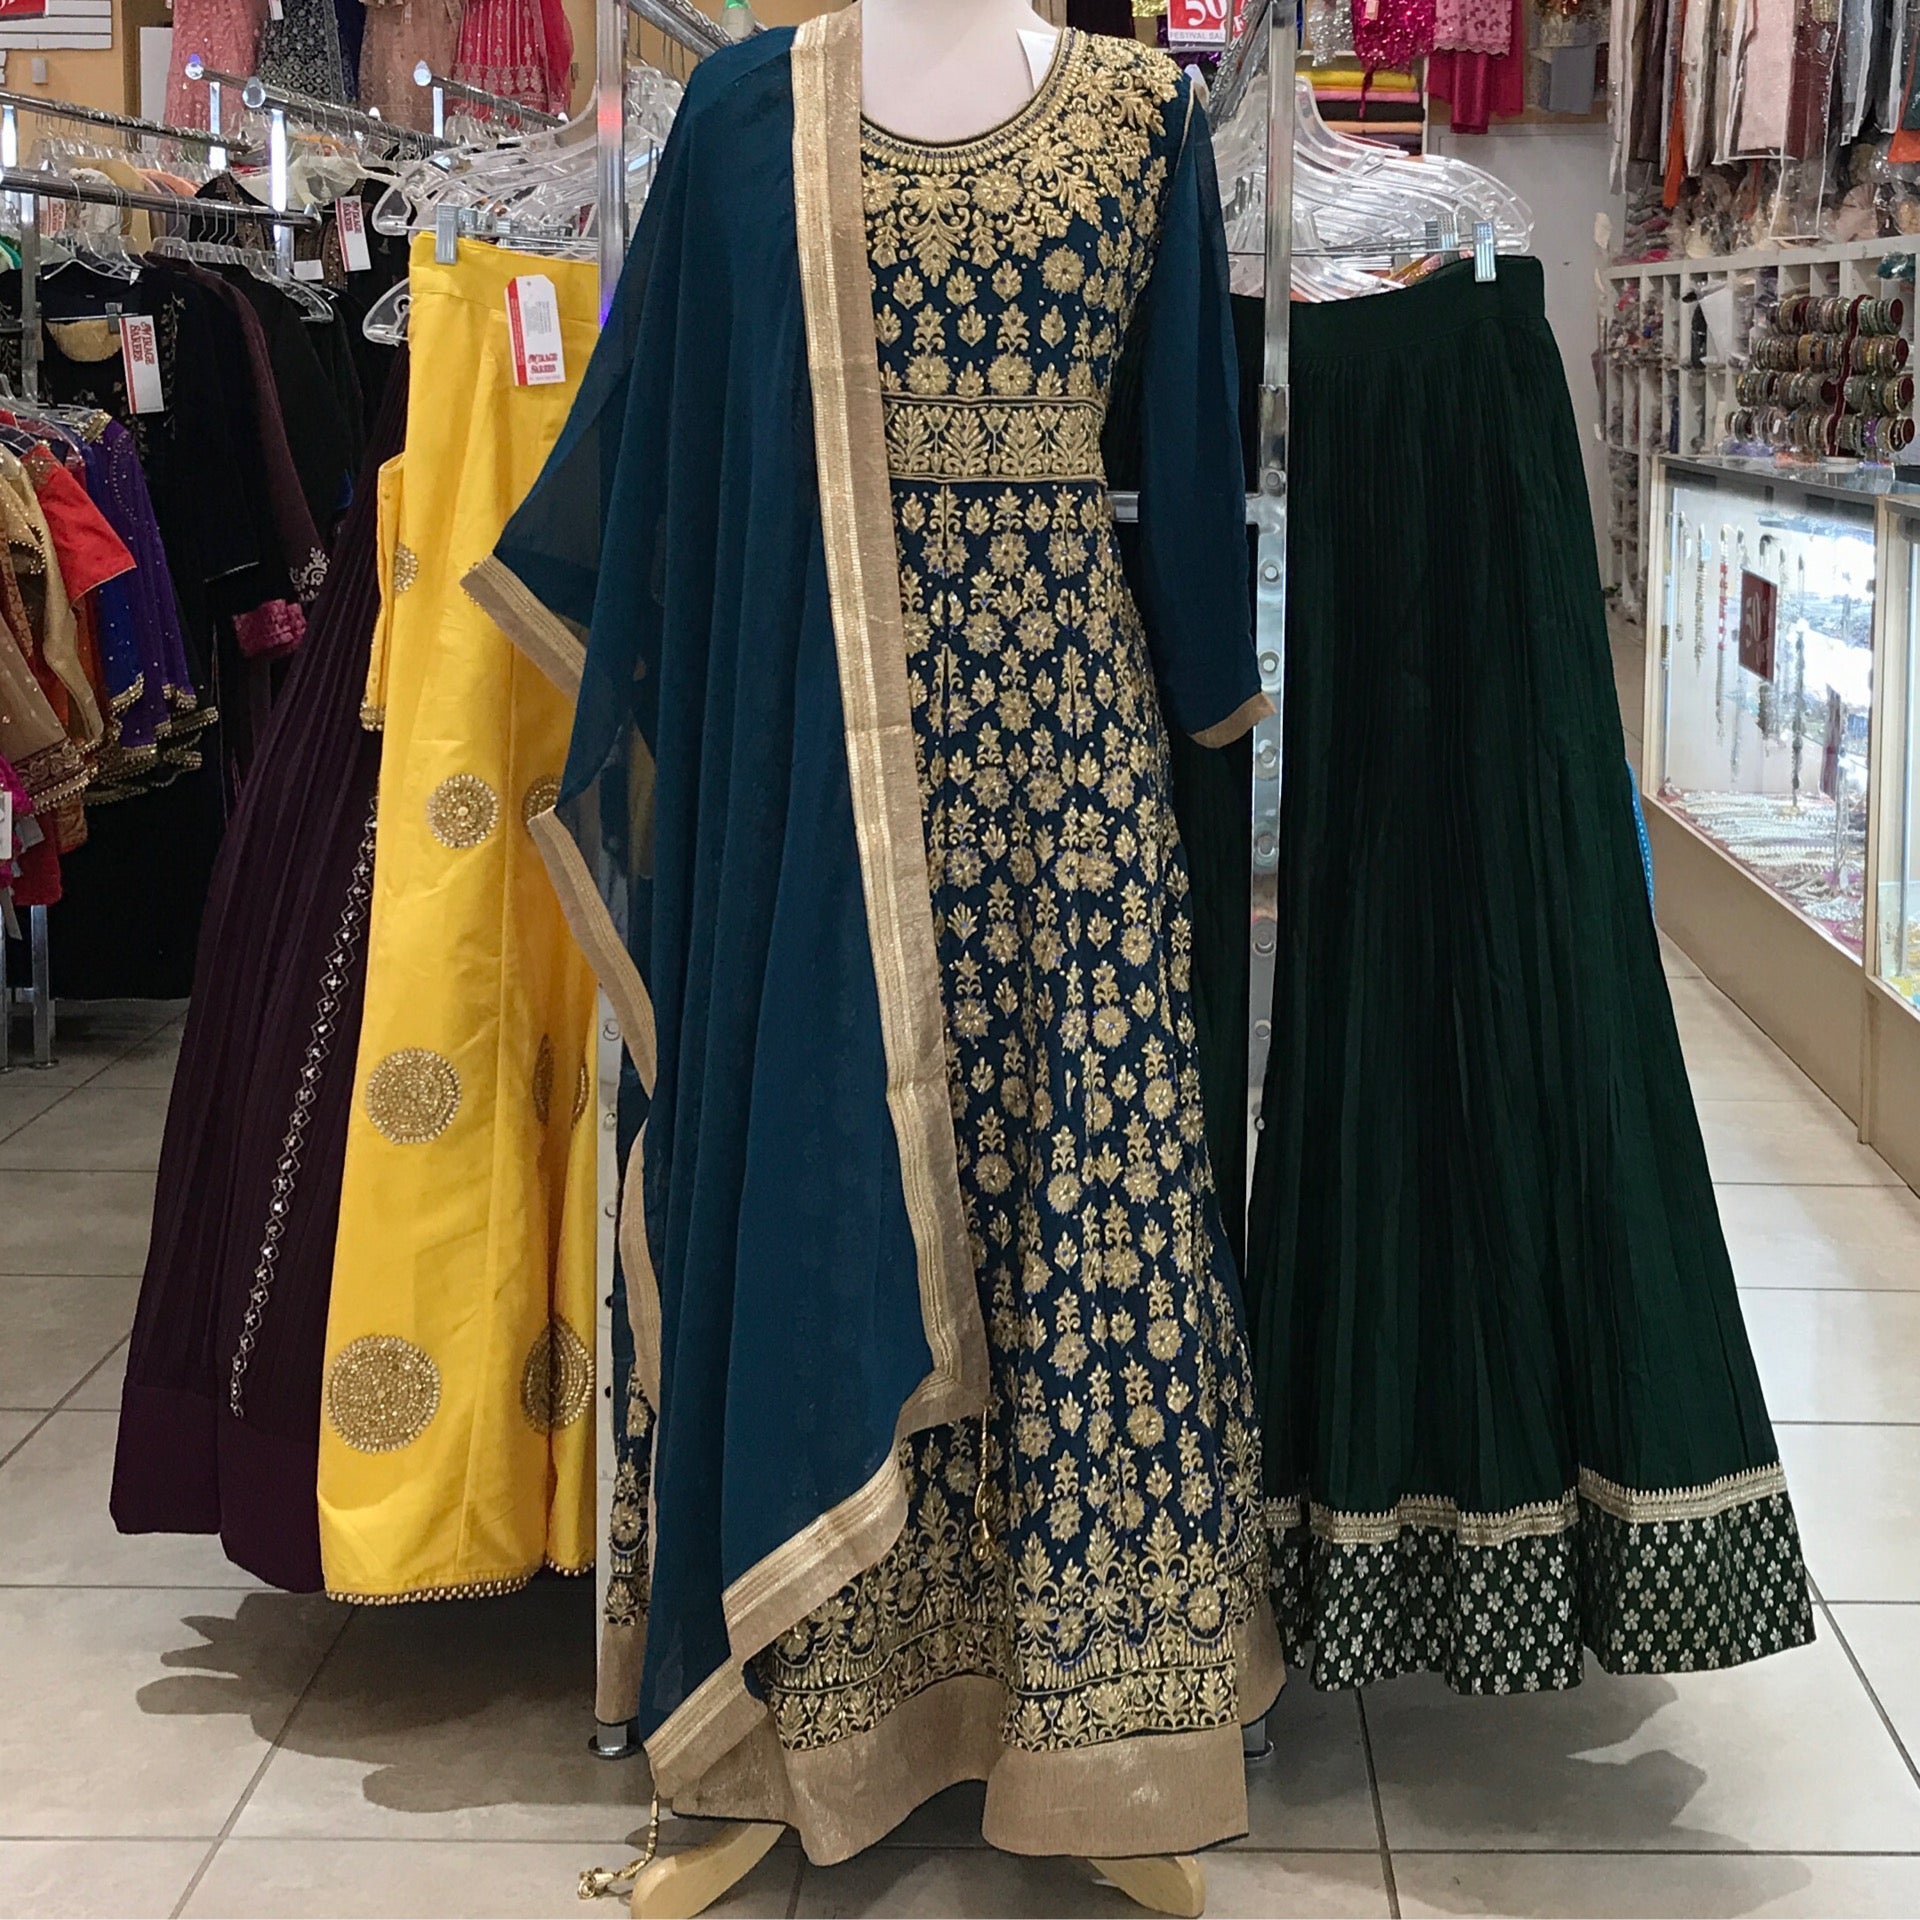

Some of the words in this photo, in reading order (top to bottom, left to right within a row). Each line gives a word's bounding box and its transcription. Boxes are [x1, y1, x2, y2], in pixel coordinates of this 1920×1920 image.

[1170, 31, 1206, 40] FESTIVAL
[1208, 31, 1225, 40] SAL
[141, 321, 155, 365] MIRAGE
